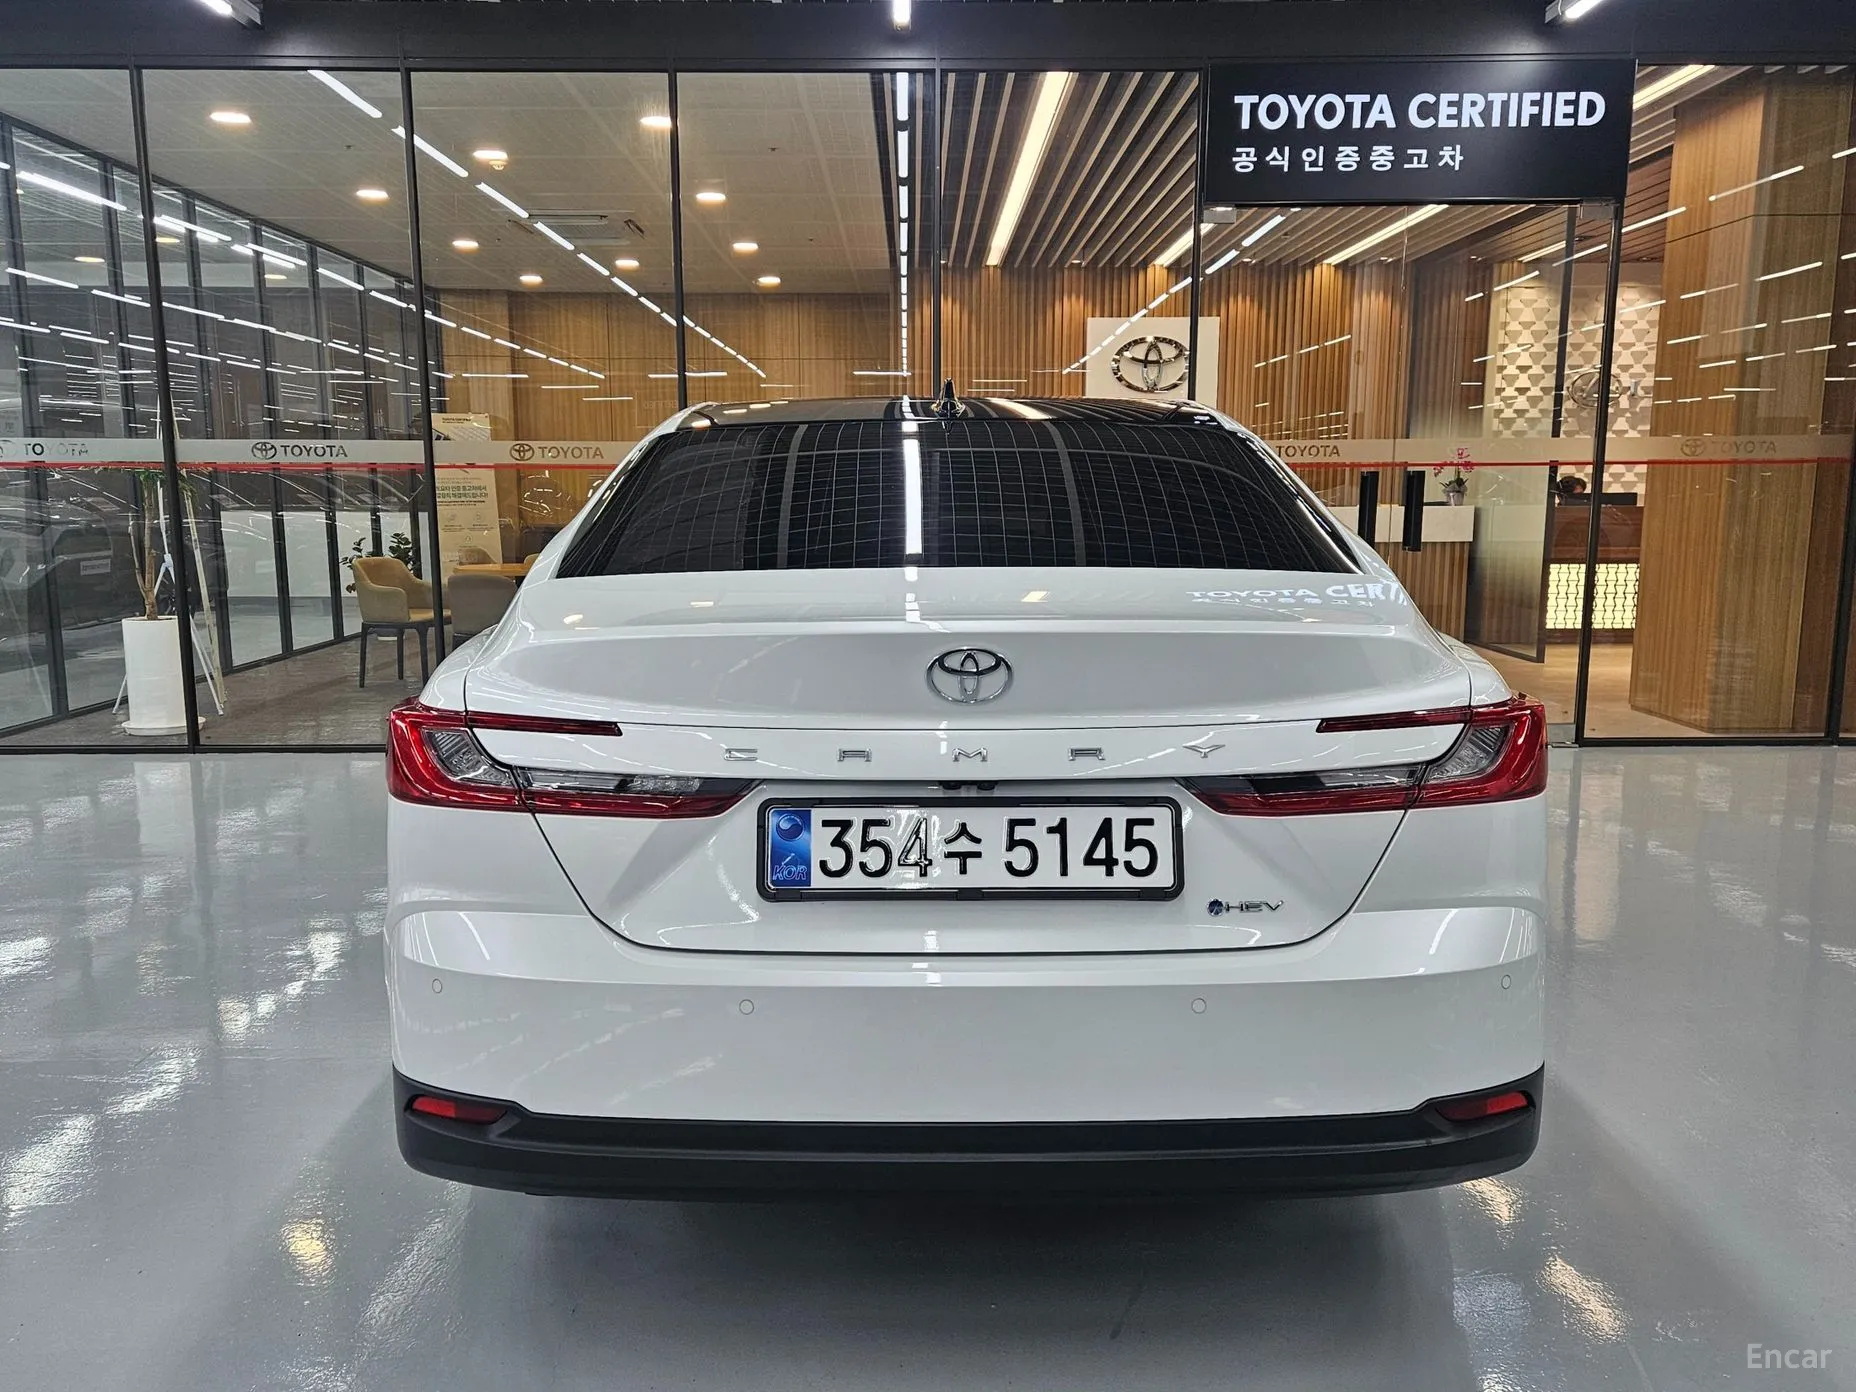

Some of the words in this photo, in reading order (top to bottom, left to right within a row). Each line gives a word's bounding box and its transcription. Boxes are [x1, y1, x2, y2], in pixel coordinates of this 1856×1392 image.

[1234, 94, 1397, 131] TOYOTA
[1408, 91, 1606, 128] CERTIFIED
[280, 444, 348, 457] TOYOTA
[538, 446, 605, 459] TOYOTA
[1275, 445, 1340, 457] TOYOTA
[1711, 440, 1777, 454] TOYOTA
[1186, 588, 1319, 598] TOYOTA
[818, 817, 983, 878] 354수
[1004, 816, 1159, 877] 5145
[772, 865, 808, 881] KOR
[1225, 900, 1284, 913] HEV
